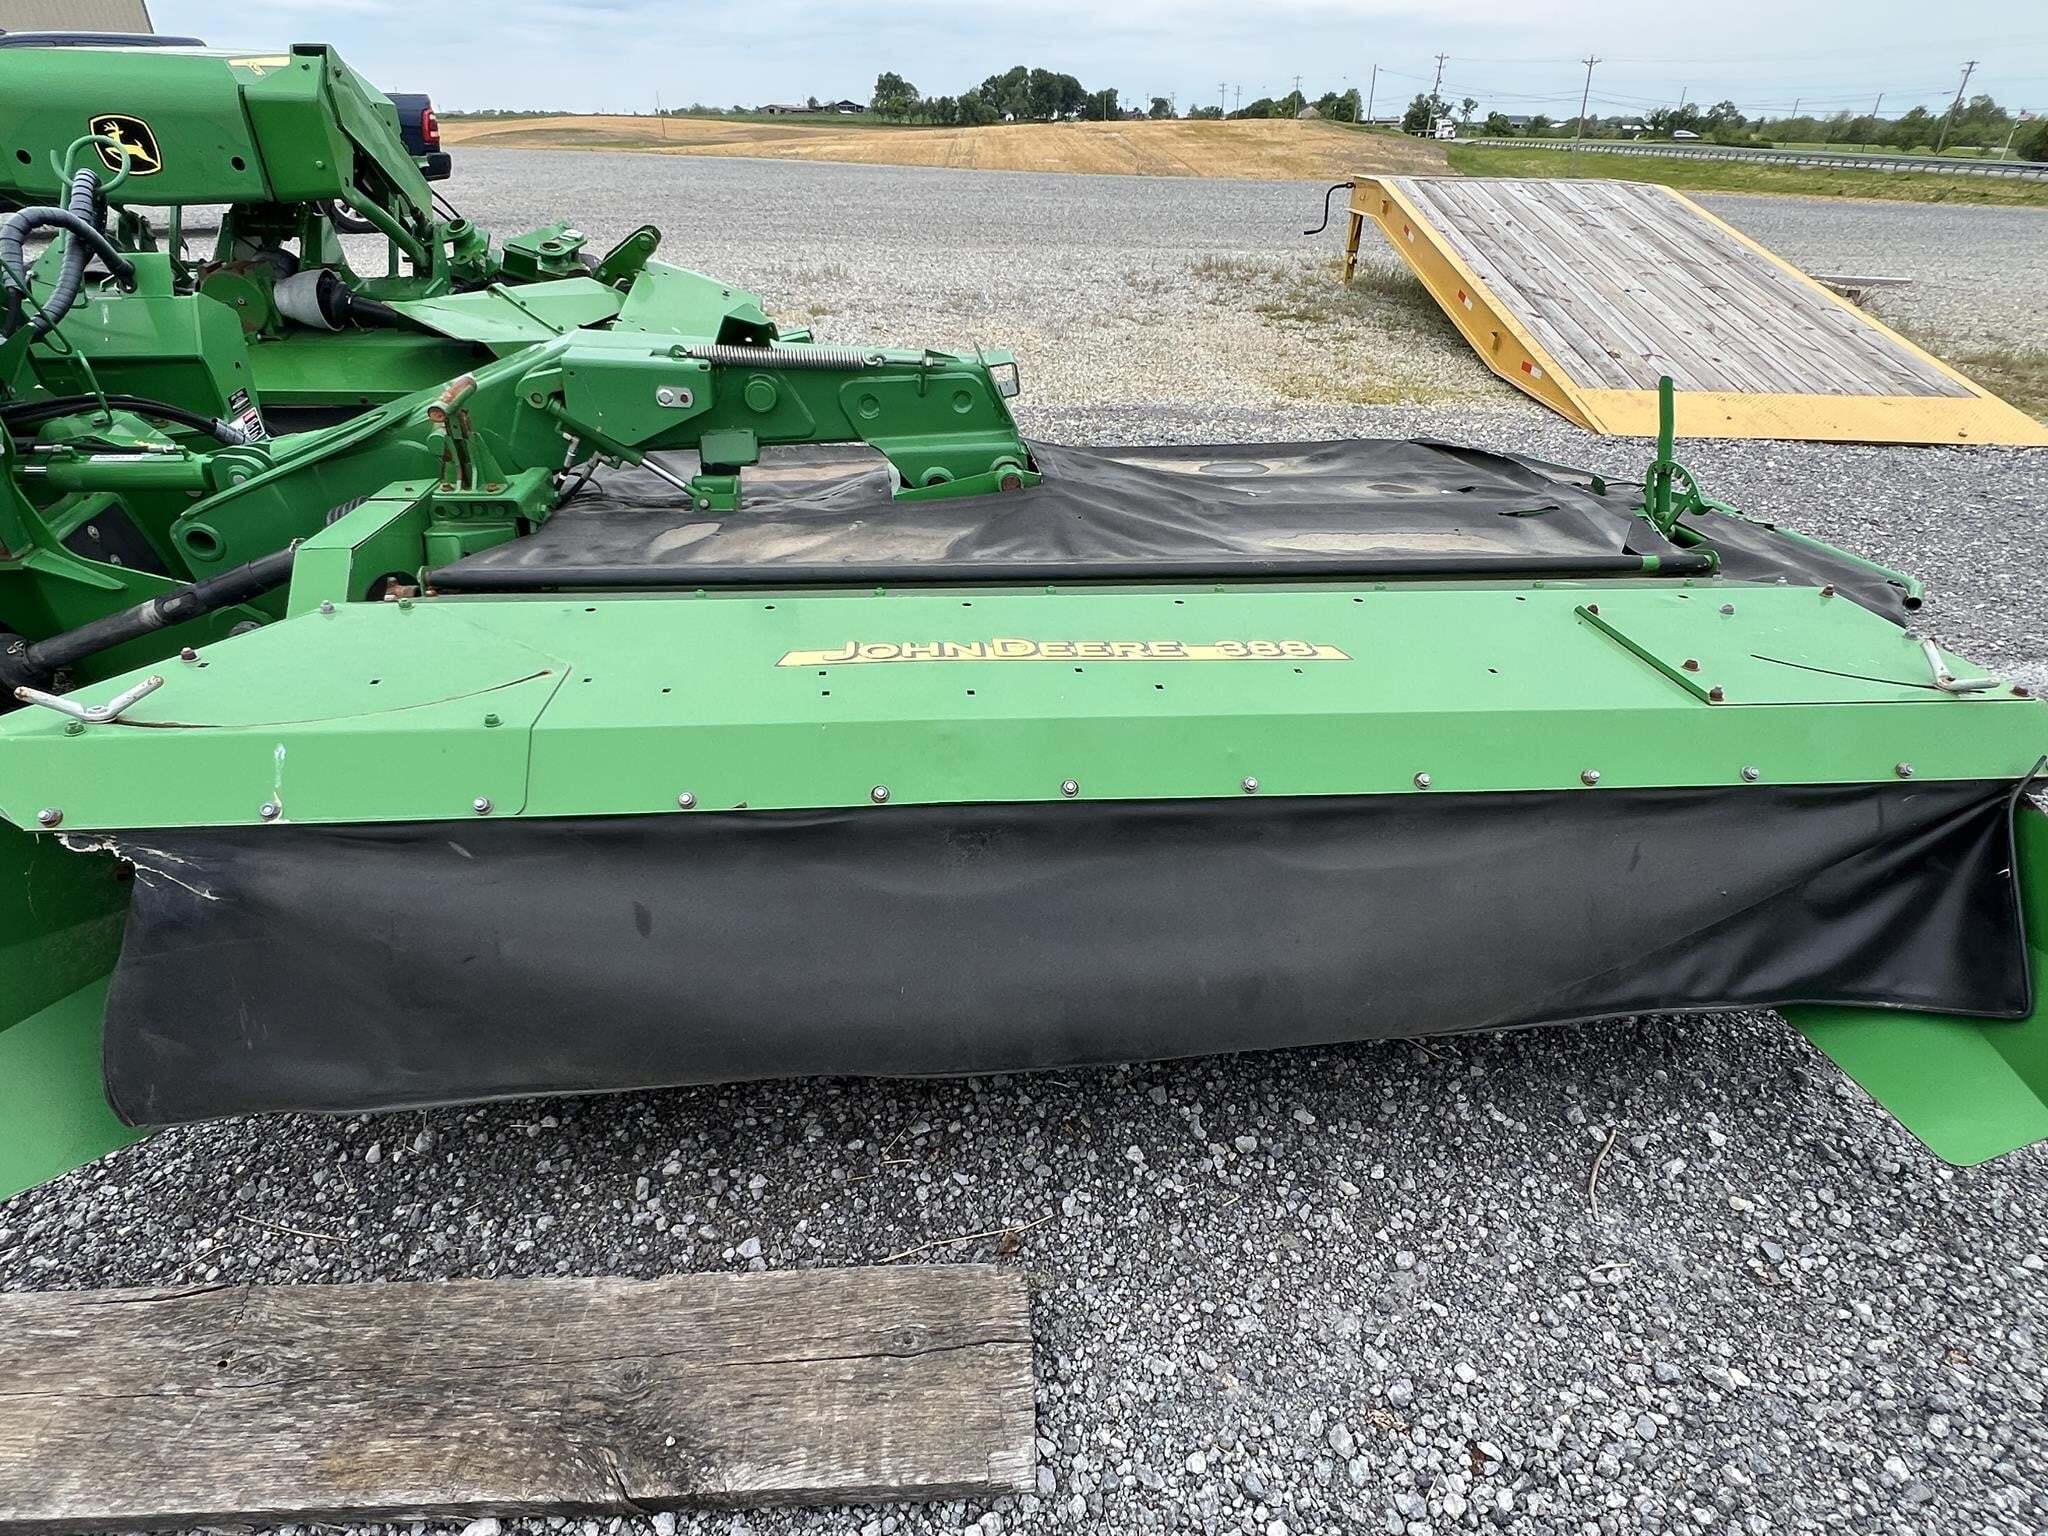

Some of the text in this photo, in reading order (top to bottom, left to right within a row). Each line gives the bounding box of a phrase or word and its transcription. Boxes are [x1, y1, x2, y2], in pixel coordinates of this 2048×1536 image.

[823, 637, 1318, 661] JOHN DEERE 388
